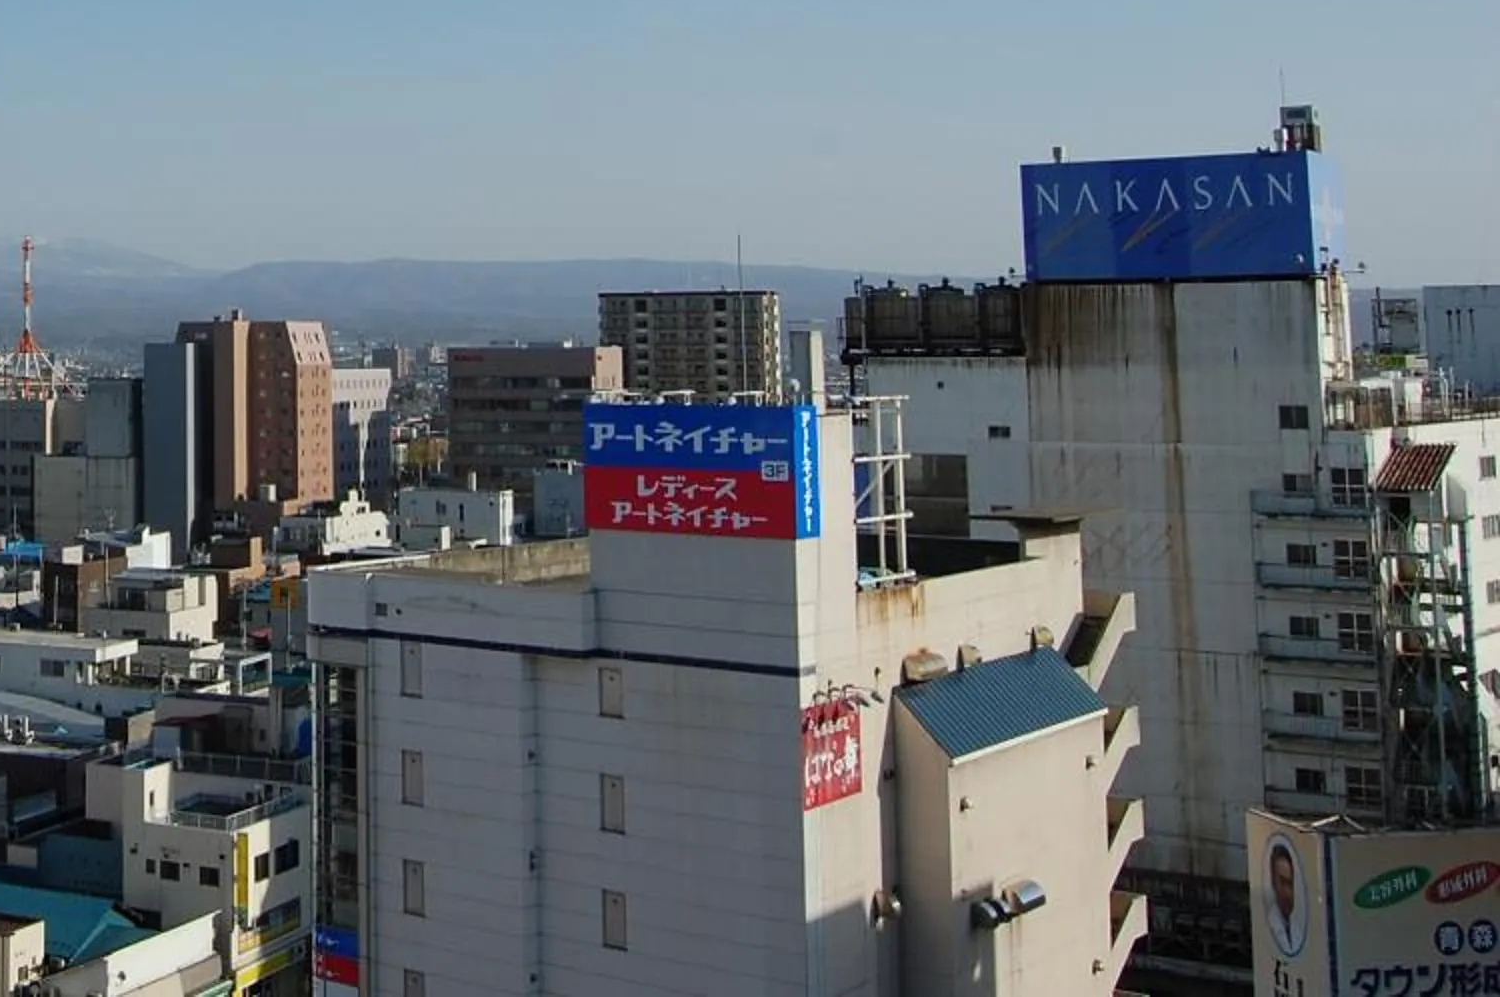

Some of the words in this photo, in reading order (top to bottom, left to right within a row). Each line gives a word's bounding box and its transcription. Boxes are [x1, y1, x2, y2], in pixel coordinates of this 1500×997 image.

[1035, 170, 1295, 217] NAKASAN
[588, 420, 789, 455] アートネイチャー
[764, 462, 787, 479] 3F
[637, 474, 738, 502] レディース
[611, 501, 769, 531] アートネイチャー
